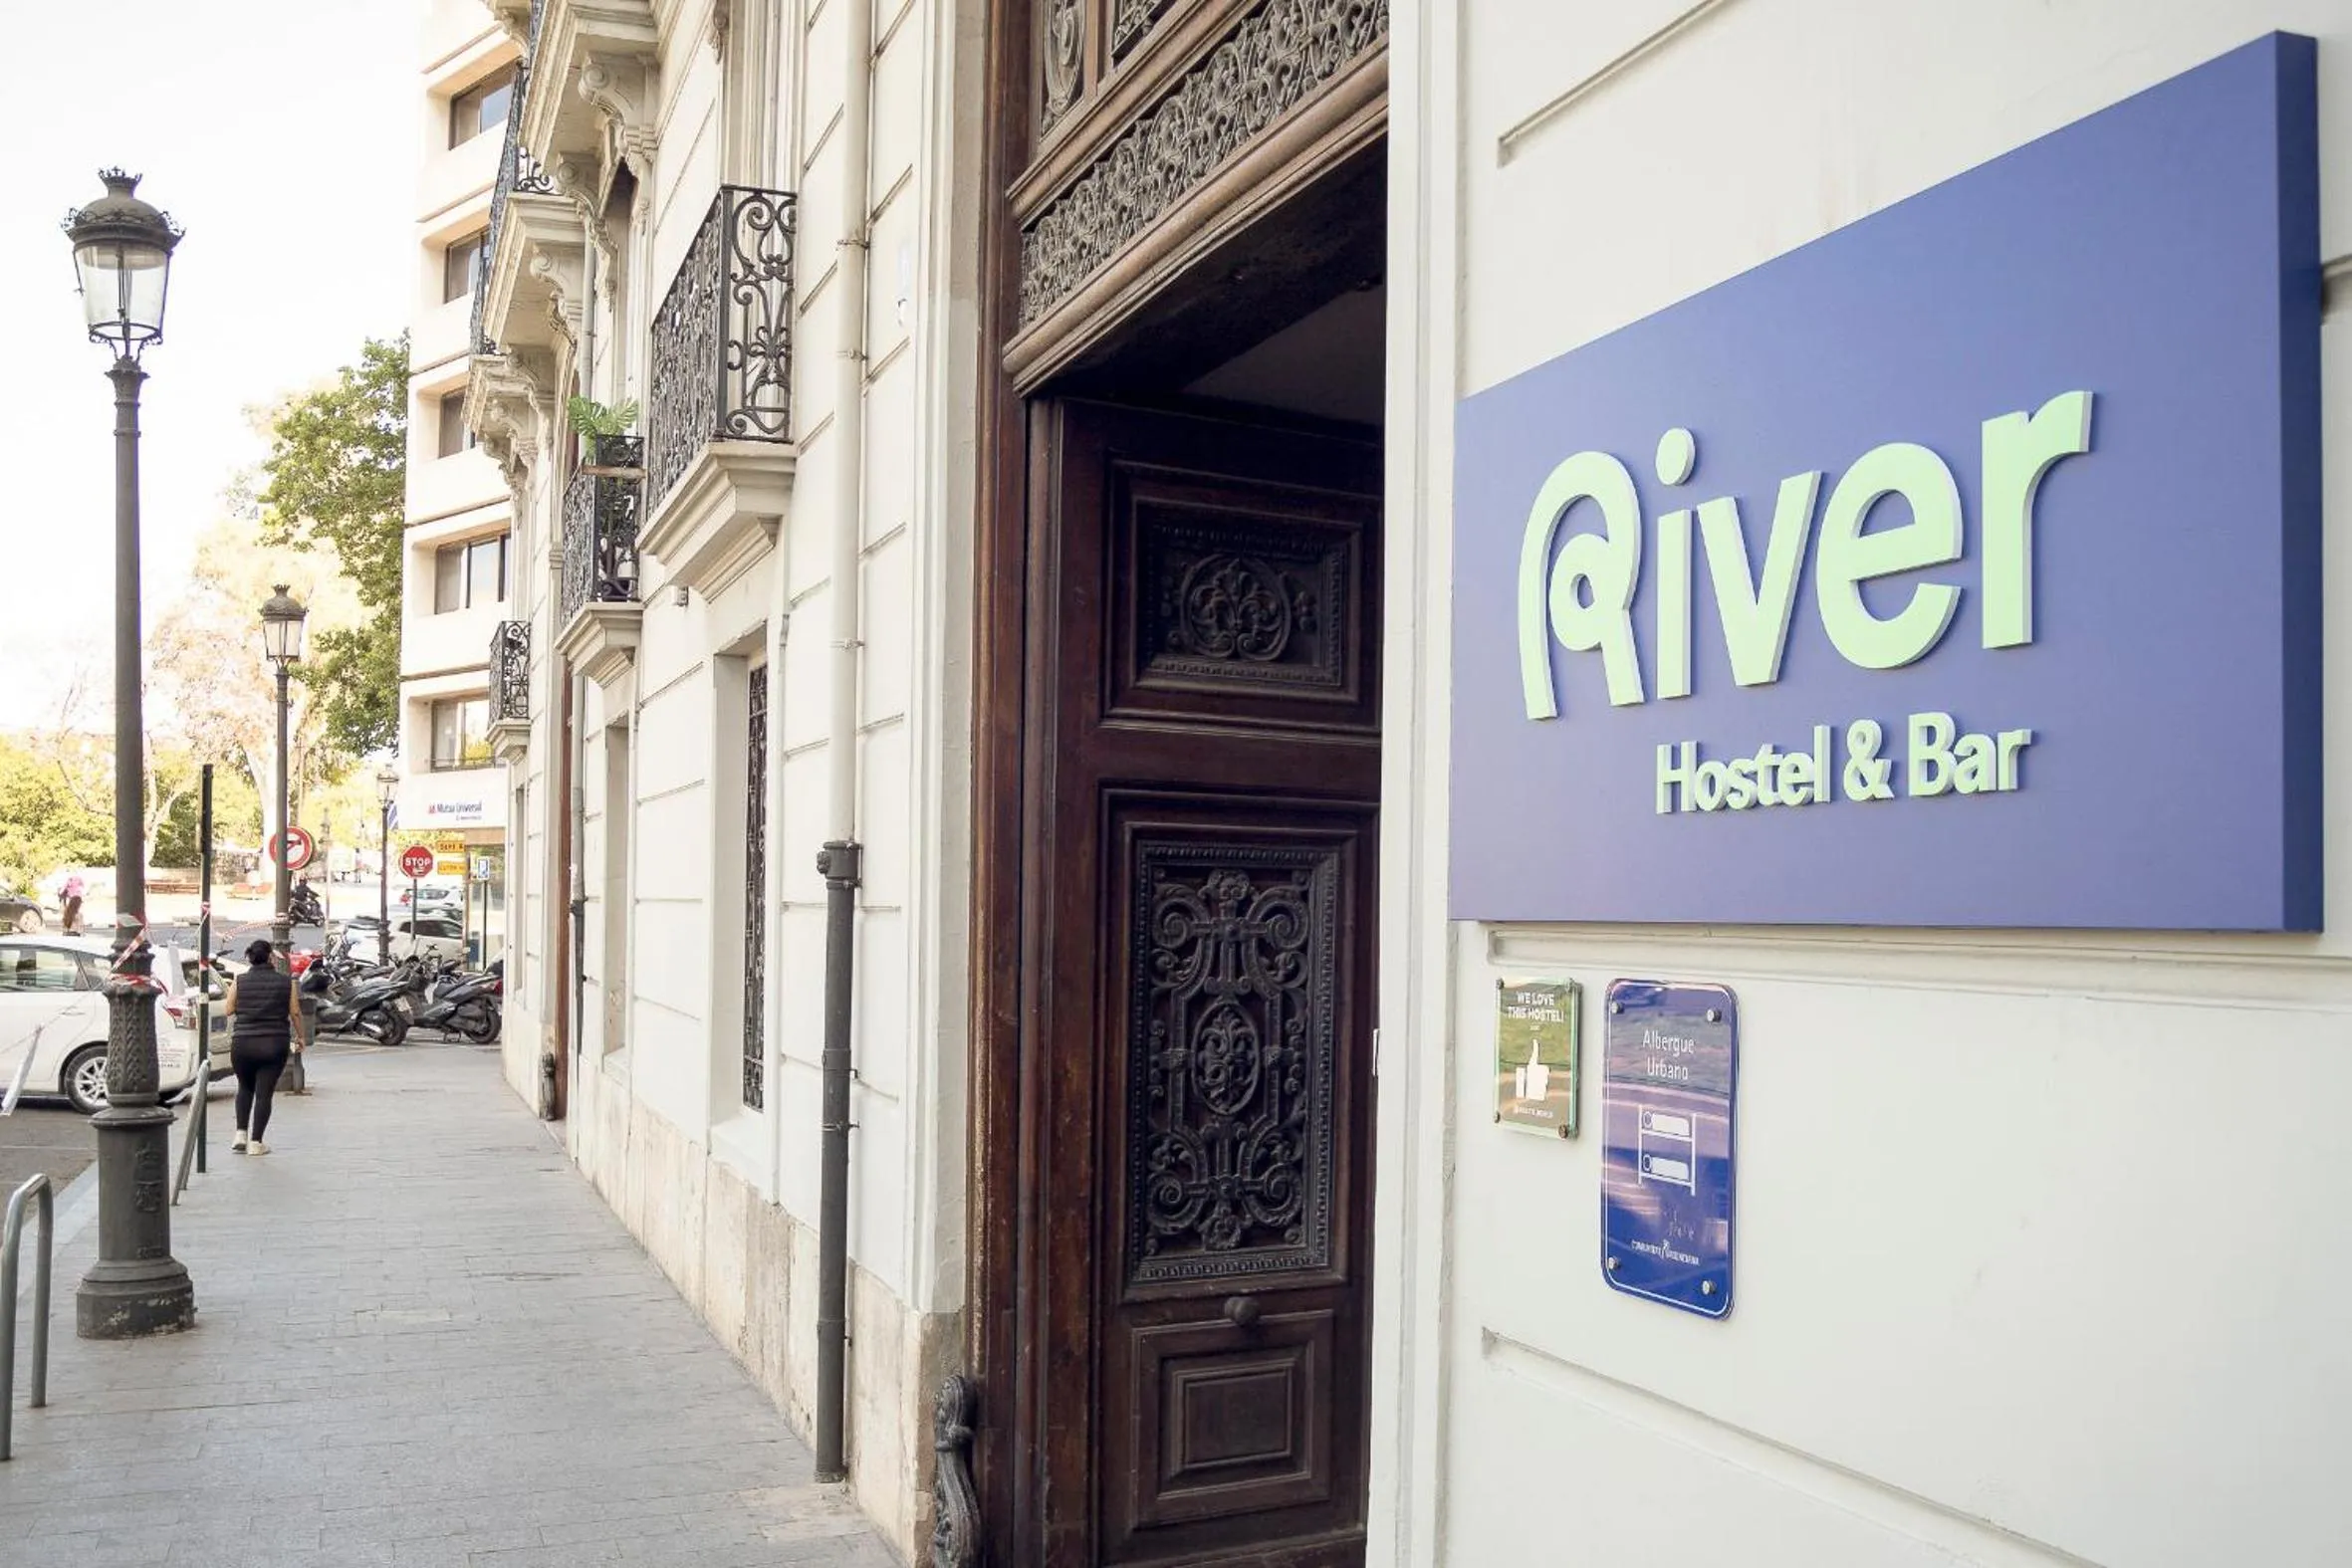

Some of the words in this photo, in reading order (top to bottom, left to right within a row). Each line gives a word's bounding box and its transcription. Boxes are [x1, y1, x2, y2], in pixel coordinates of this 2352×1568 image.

[1518, 390, 2093, 721] River
[1655, 725, 1831, 814] Hostel
[1843, 719, 1895, 802] &
[1908, 712, 2031, 797] Bar
[456, 801, 482, 813] Universal
[405, 857, 431, 866] STOP
[1517, 992, 1531, 1005] WE
[1531, 993, 1554, 1007] LOVE
[1508, 1006, 1528, 1019] THIS
[1642, 1029, 1695, 1057] Albergue
[1647, 1056, 1689, 1080] Urbano
